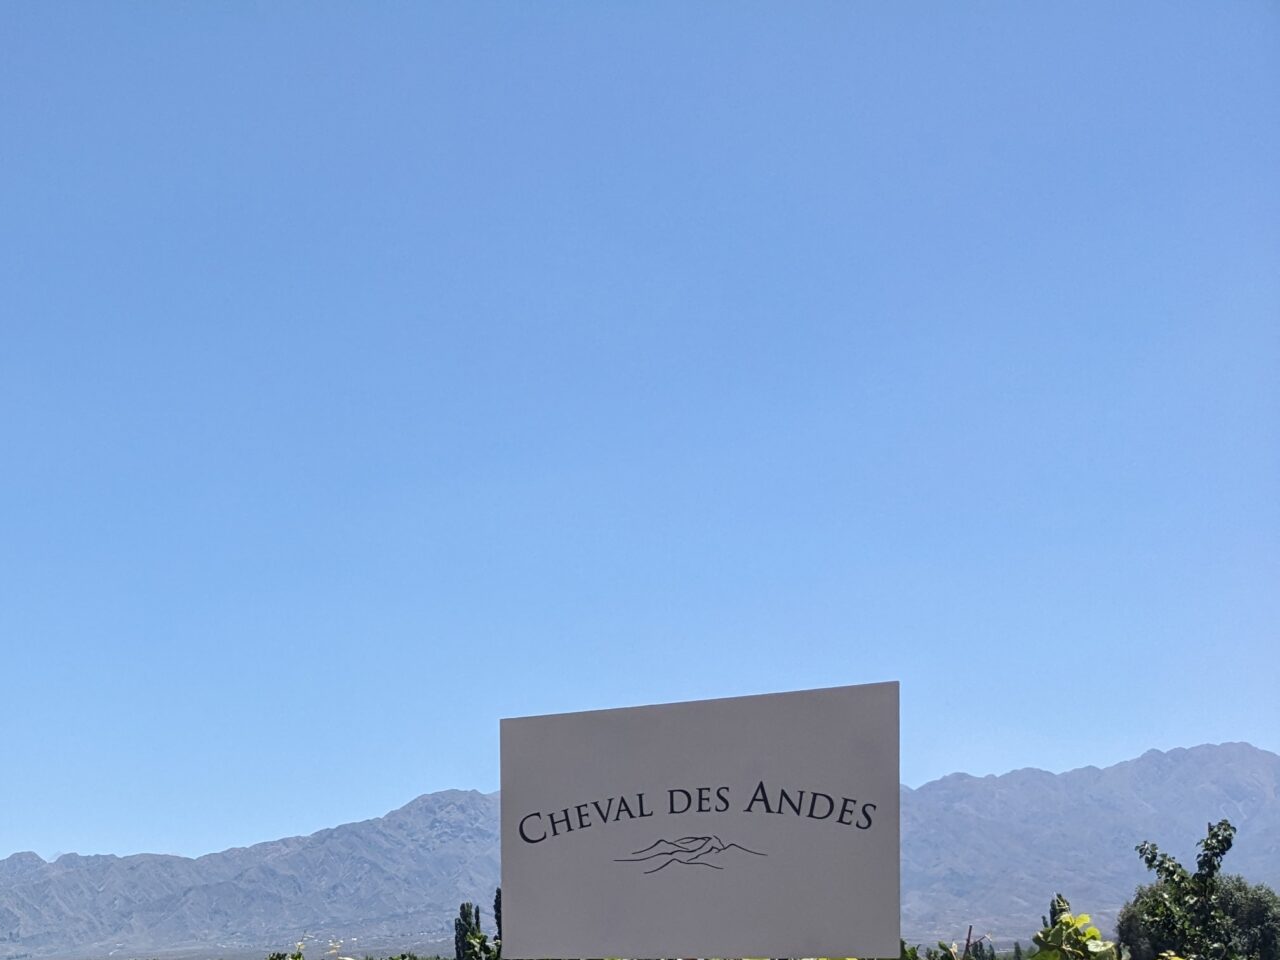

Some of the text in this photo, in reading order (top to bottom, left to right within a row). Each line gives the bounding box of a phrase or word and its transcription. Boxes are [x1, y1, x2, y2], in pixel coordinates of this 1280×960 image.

[518, 780, 877, 844] CHEVAL DES ANDES
